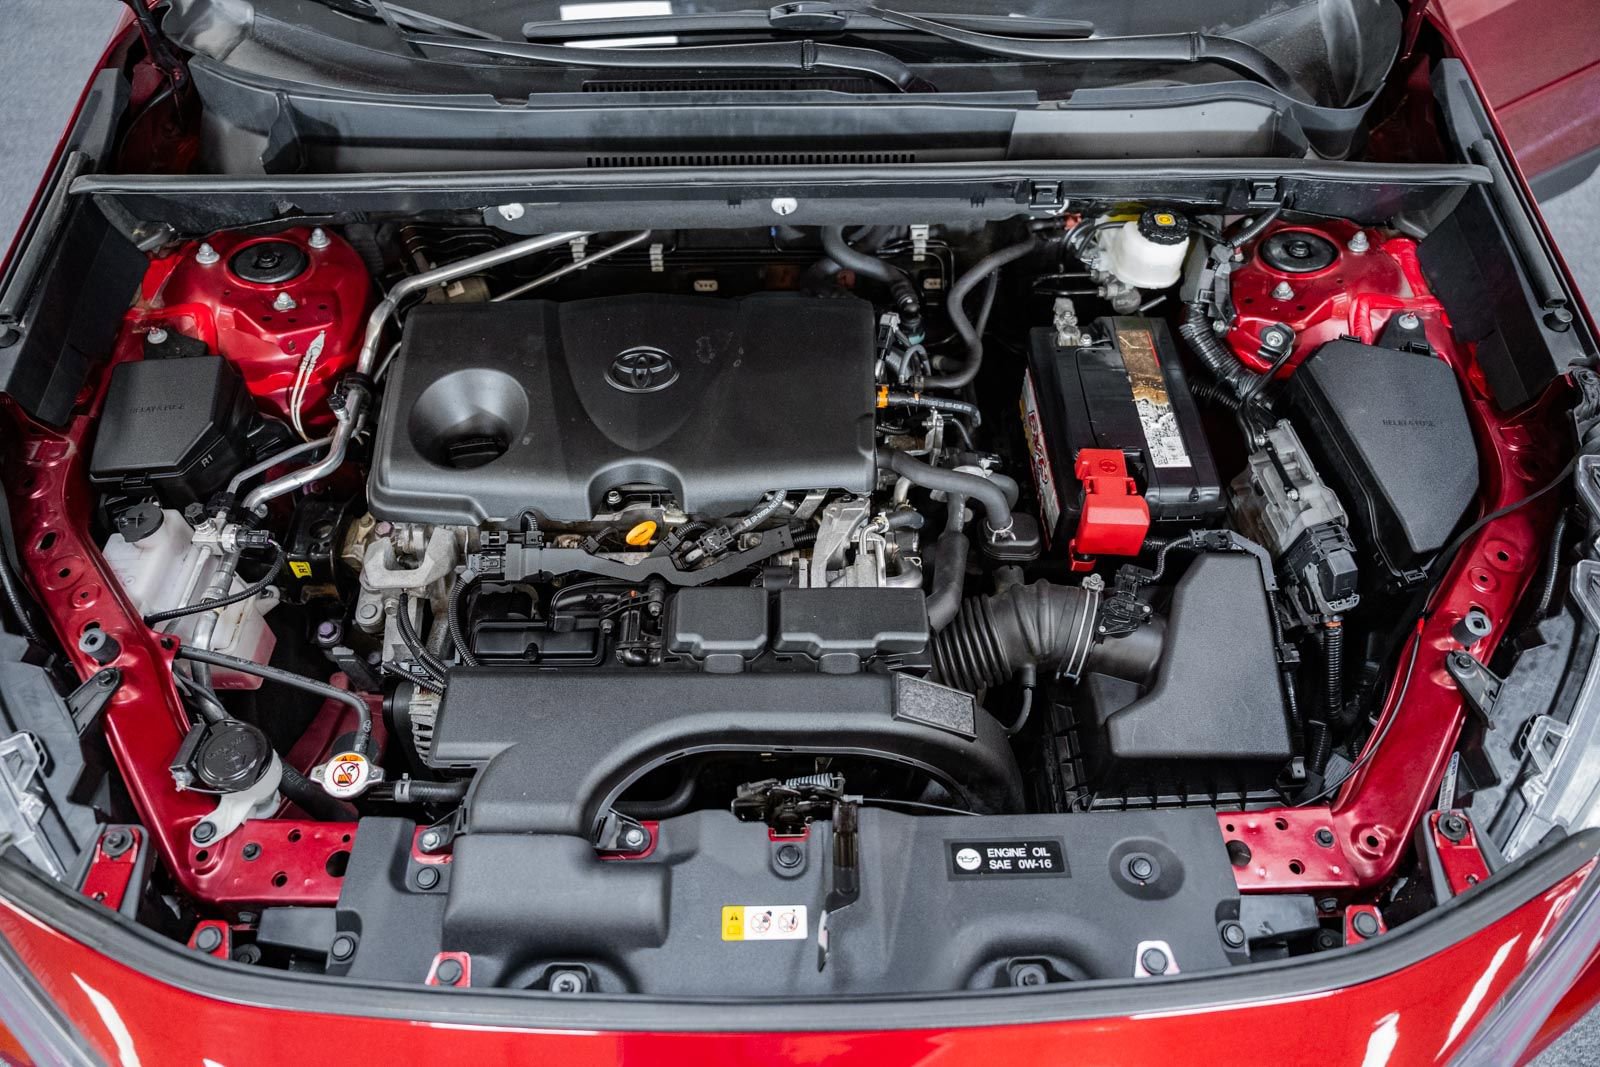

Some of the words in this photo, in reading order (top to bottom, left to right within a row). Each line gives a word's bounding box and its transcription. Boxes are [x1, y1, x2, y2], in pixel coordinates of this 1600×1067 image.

[201, 454, 214, 468] R1
[986, 848, 1027, 858] ENGINE
[1032, 847, 1051, 857] OIL
[988, 860, 1012, 870] SAE
[1017, 859, 1053, 869] 0W-16
